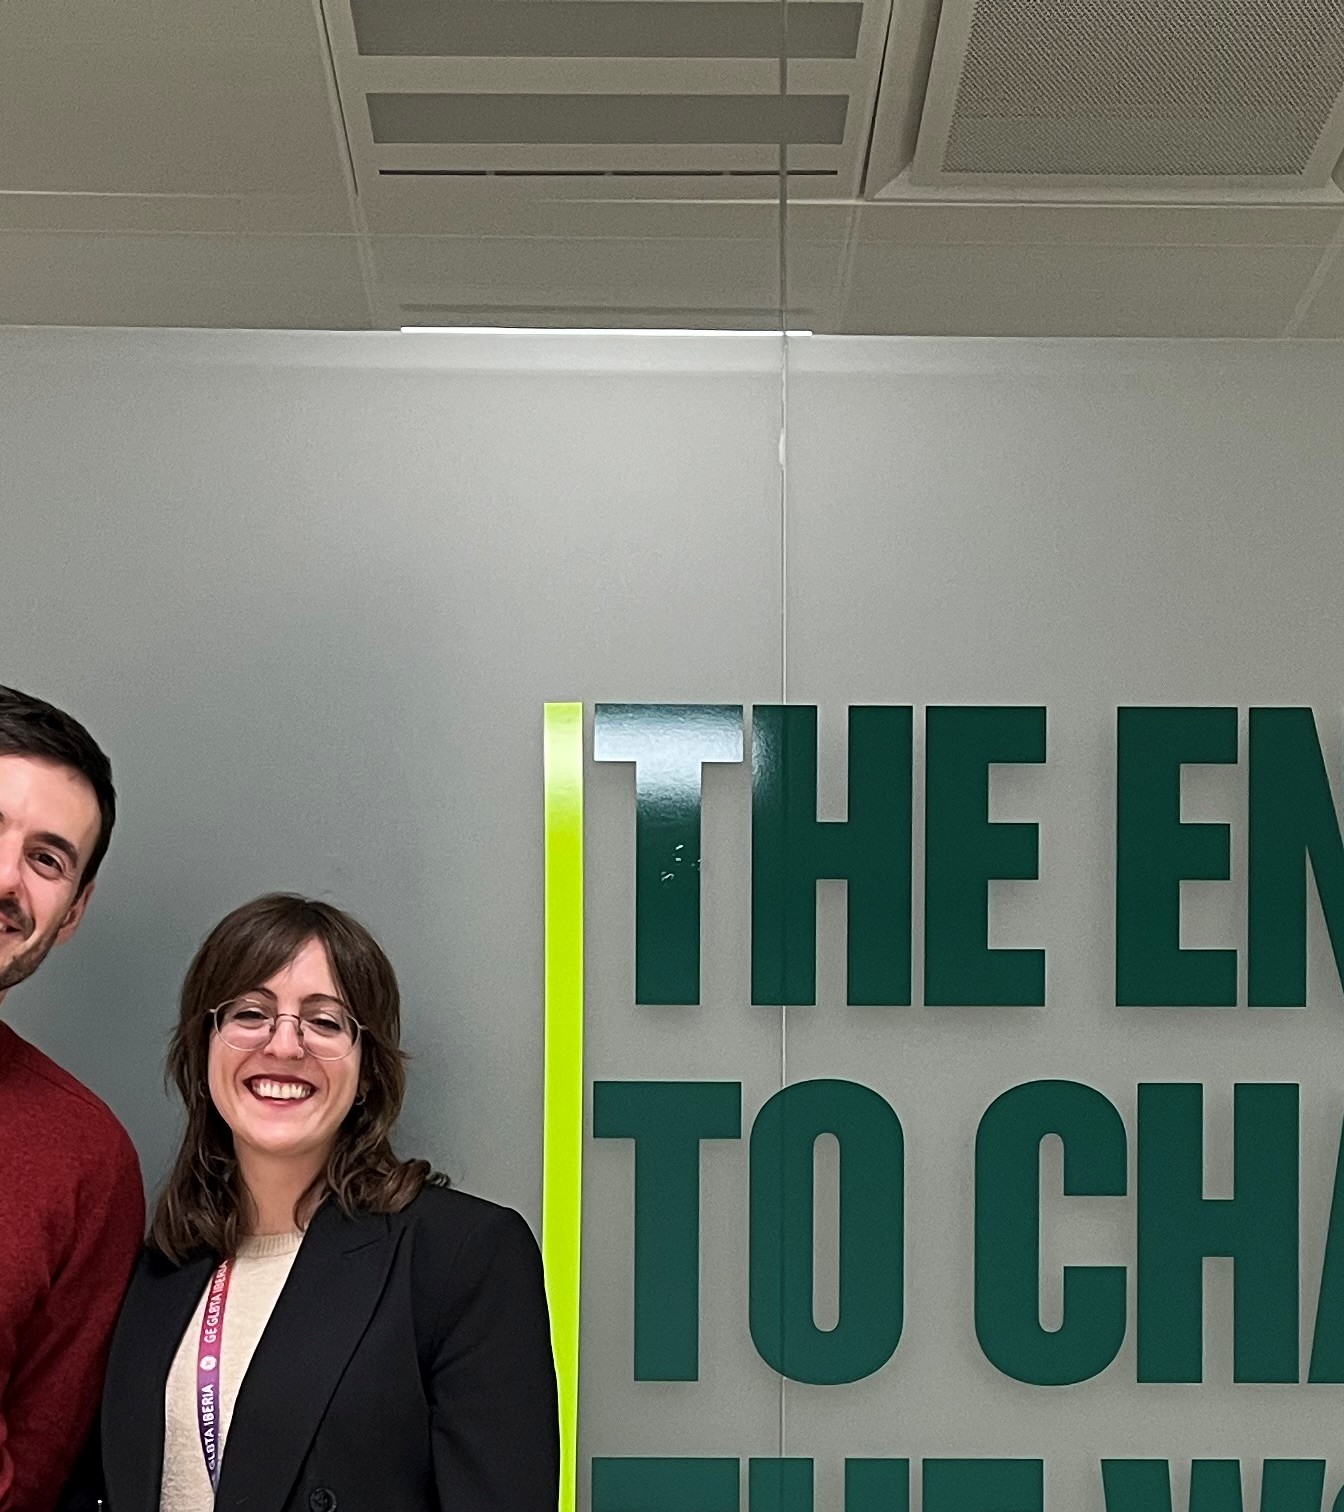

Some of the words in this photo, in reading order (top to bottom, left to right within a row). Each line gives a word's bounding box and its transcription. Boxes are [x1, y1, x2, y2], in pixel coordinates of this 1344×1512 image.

[594, 704, 1047, 1007] THE
[592, 1079, 905, 1386] TO
[206, 1293, 222, 1326] GLBTA
[204, 1327, 217, 1344] GE
[201, 1384, 215, 1426] IBERIA
